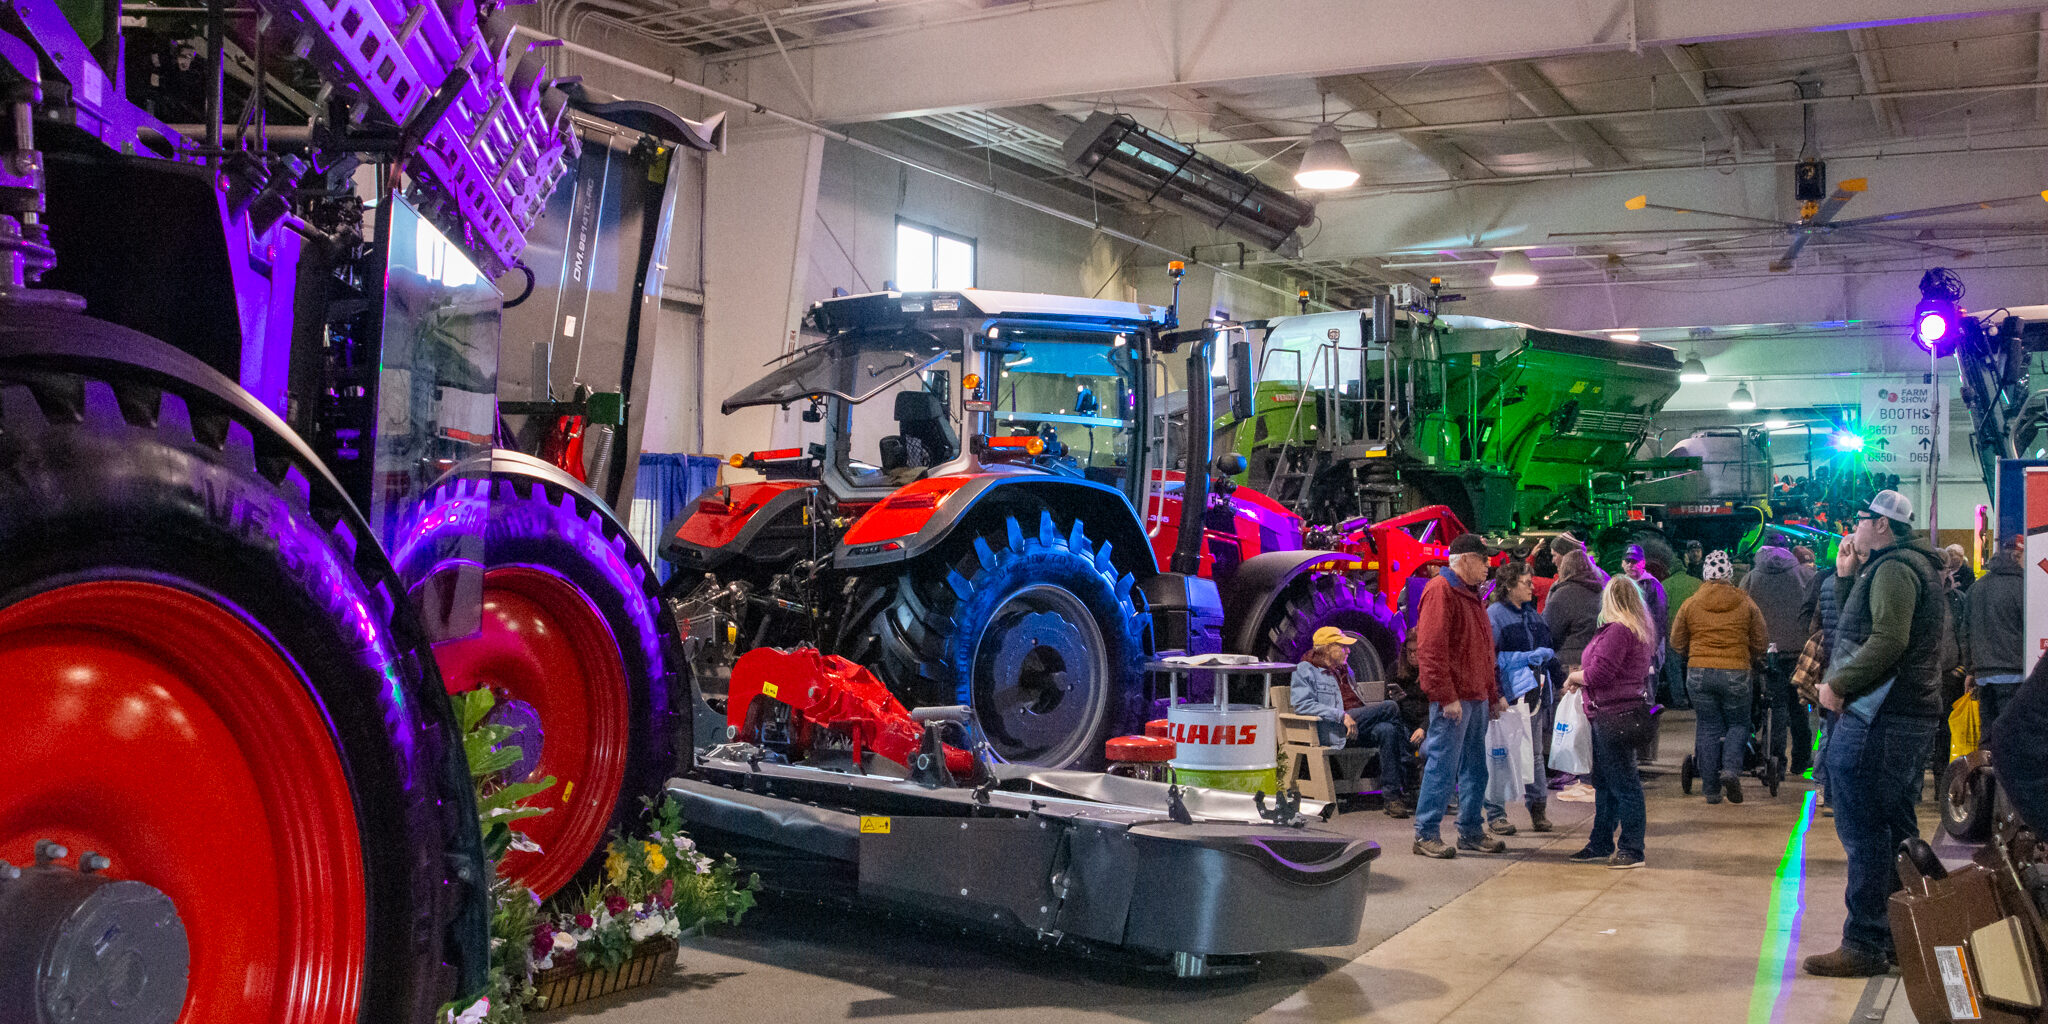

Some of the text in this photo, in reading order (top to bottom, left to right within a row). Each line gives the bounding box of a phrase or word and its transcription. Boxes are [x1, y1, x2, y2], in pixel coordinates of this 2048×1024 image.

[1901, 388, 1928, 397] FARM
[1900, 396, 1928, 404] SHOW
[1880, 408, 1929, 420] BOOTHS
[1680, 504, 1721, 514] FENDT
[1168, 722, 1258, 745] CLAAS
